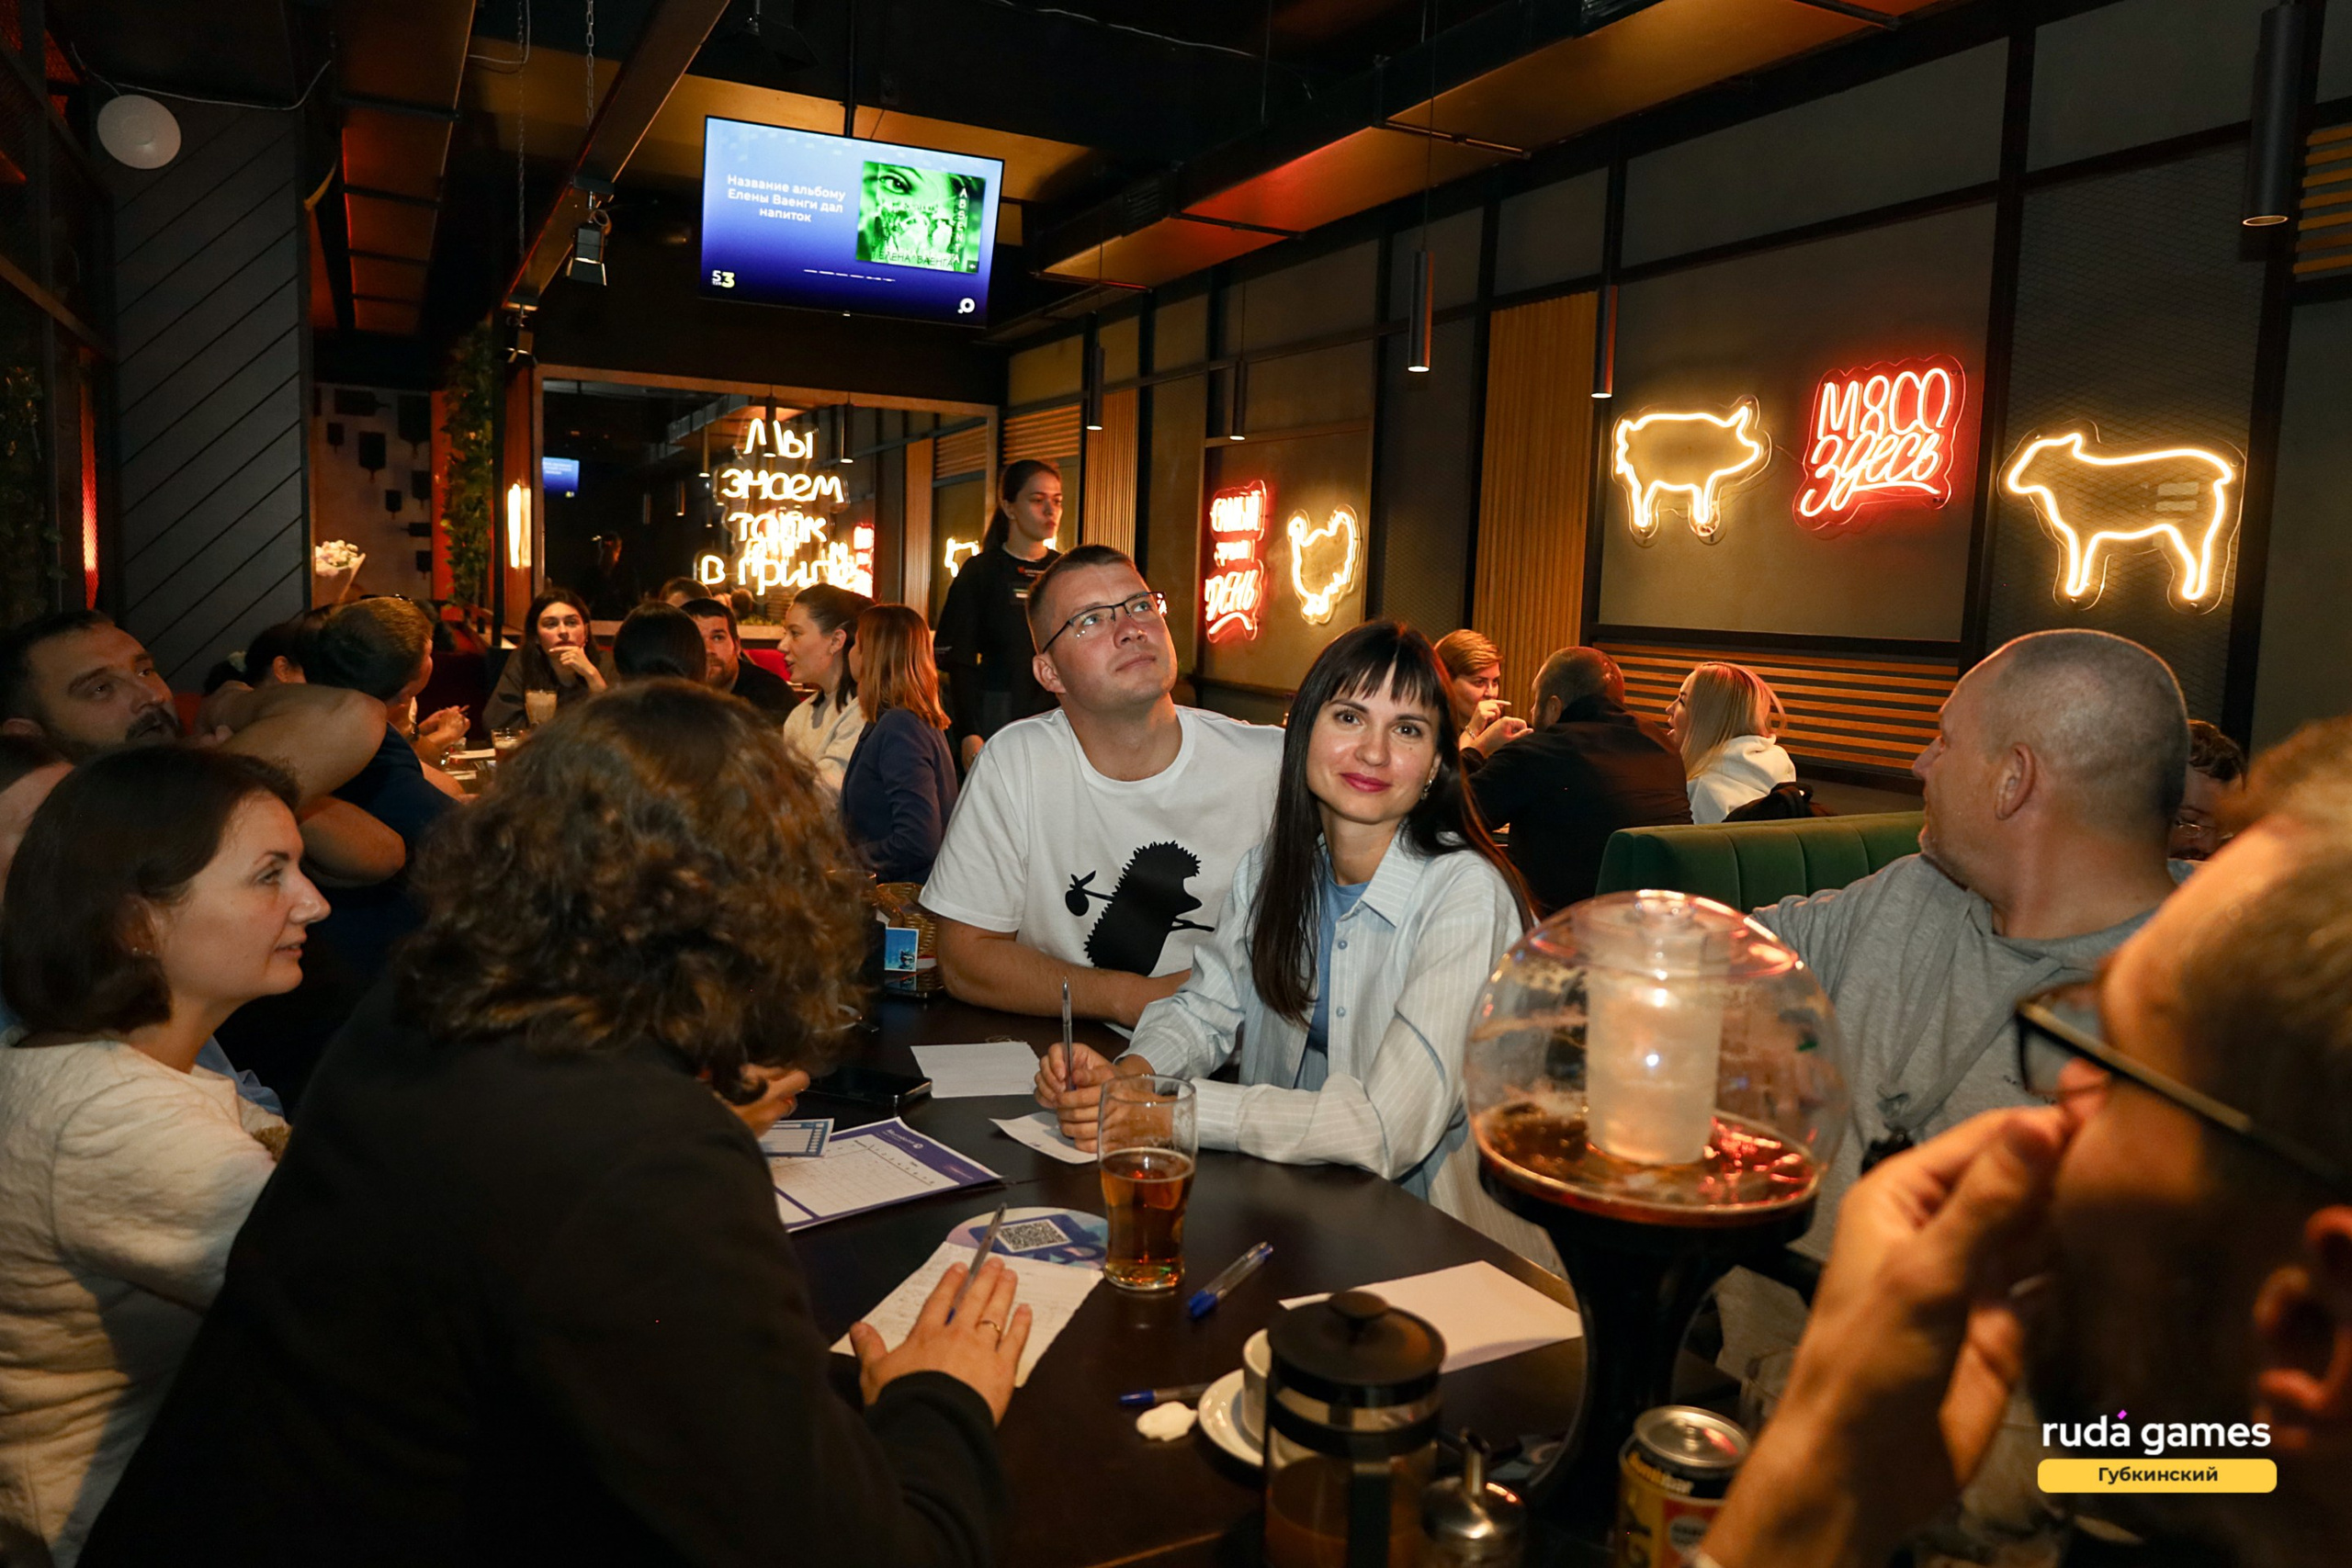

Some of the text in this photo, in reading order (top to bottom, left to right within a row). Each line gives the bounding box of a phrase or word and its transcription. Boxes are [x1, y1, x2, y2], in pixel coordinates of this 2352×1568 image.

[727, 174, 846, 202] Название альбому
[728, 187, 843, 214] Елены Ваенги дал
[759, 208, 812, 222] напиток
[952, 186, 968, 264] ABSENTA
